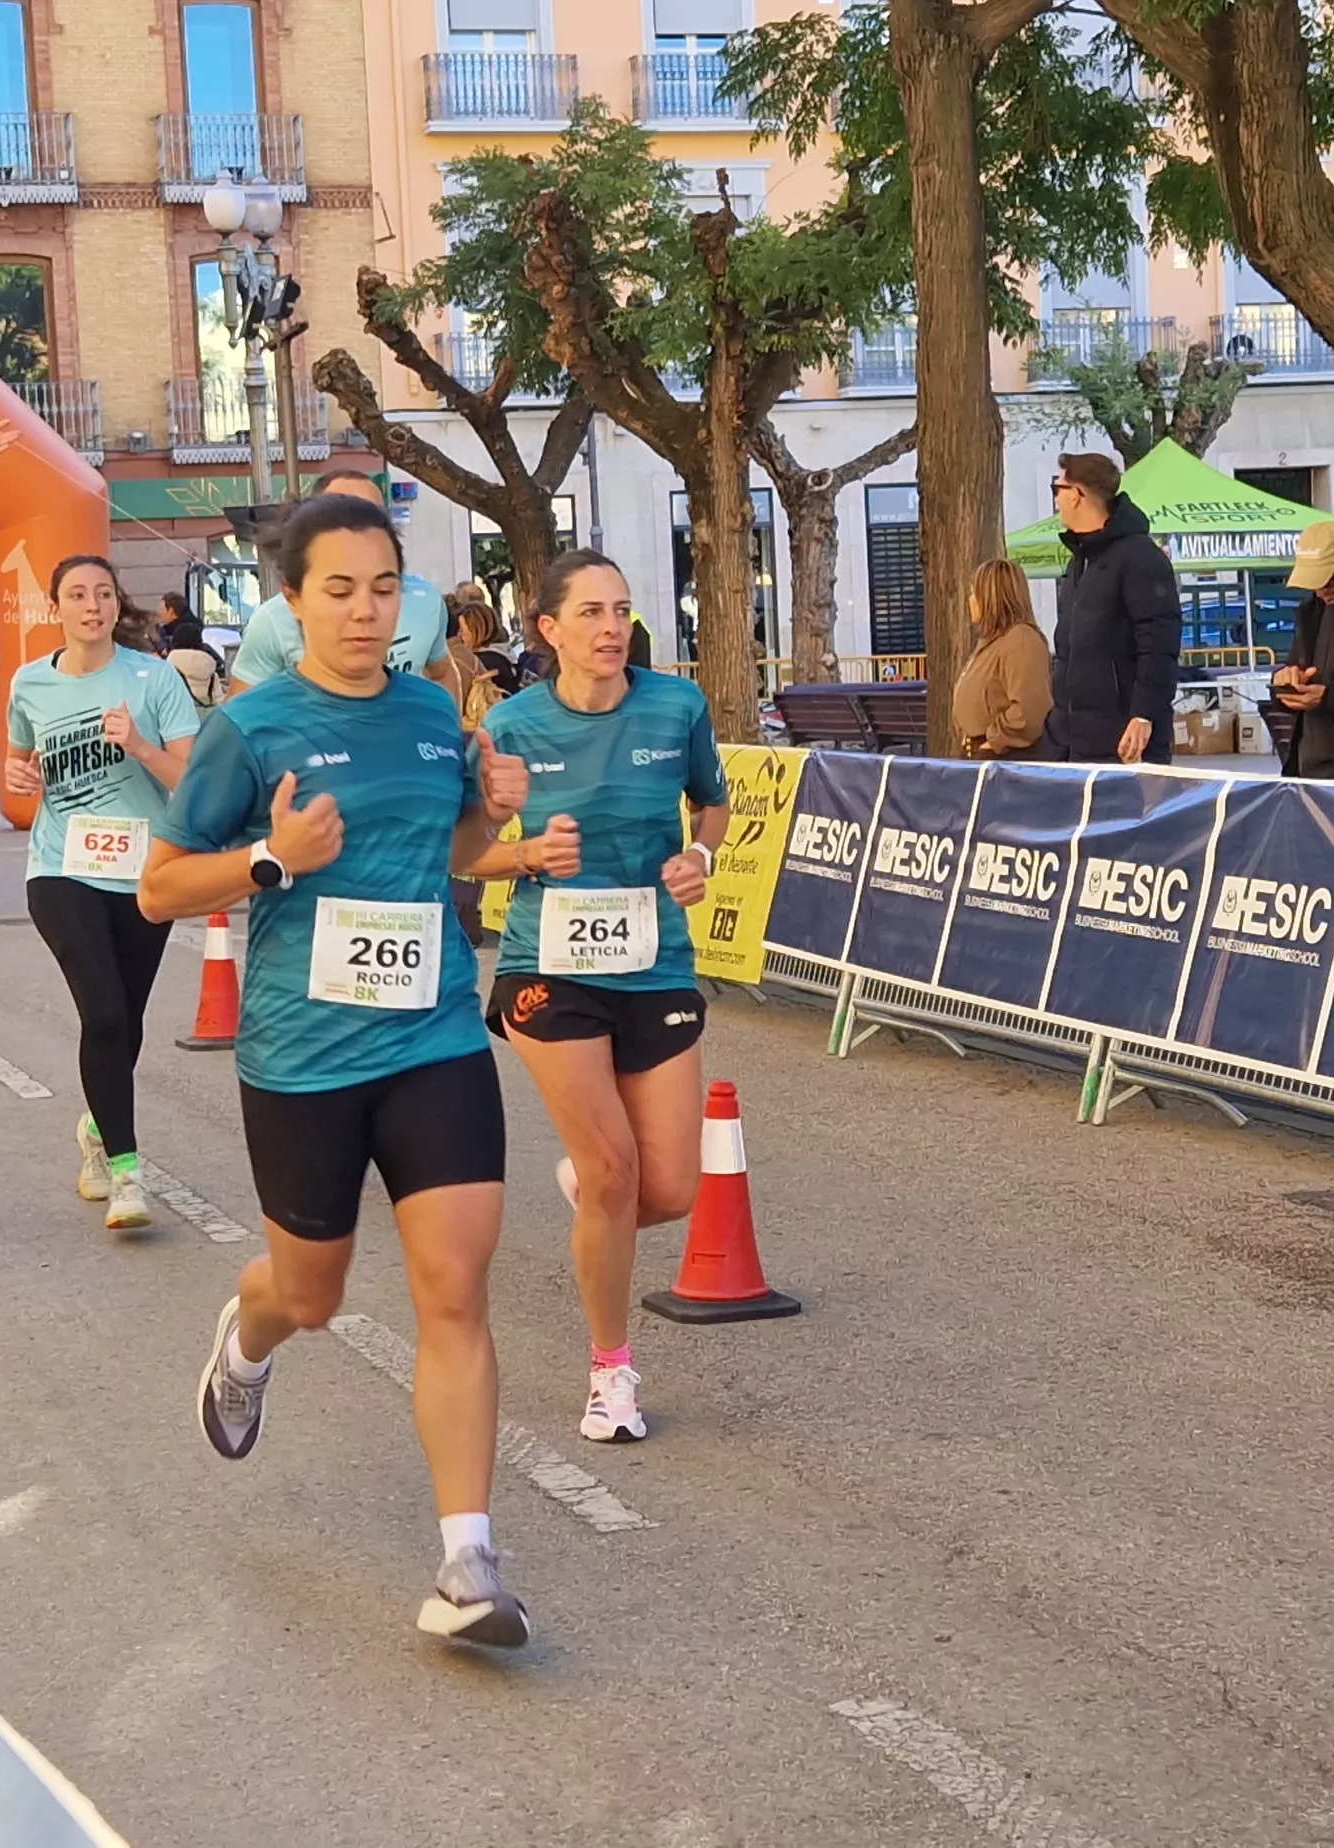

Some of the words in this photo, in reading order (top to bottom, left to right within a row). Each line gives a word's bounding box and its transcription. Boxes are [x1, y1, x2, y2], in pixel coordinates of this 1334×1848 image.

[1177, 501, 1269, 512] FARTLECK
[1190, 512, 1278, 524] SPORT
[3, 609, 20, 624] de
[45, 735, 57, 752] III
[85, 832, 129, 853] 625
[806, 815, 862, 866] ESIC
[95, 854, 118, 863] ANA
[892, 830, 955, 884] ESIC
[990, 844, 1060, 902] ESIC
[582, 895, 630, 905] CARRERA
[1103, 860, 1189, 923] ESIC
[370, 911, 424, 923] CARRERA
[1241, 879, 1332, 944] ESIC
[568, 917, 631, 942] 264
[347, 936, 422, 969] 266
[571, 946, 629, 957] LETICIA
[354, 985, 380, 1002] 8K
